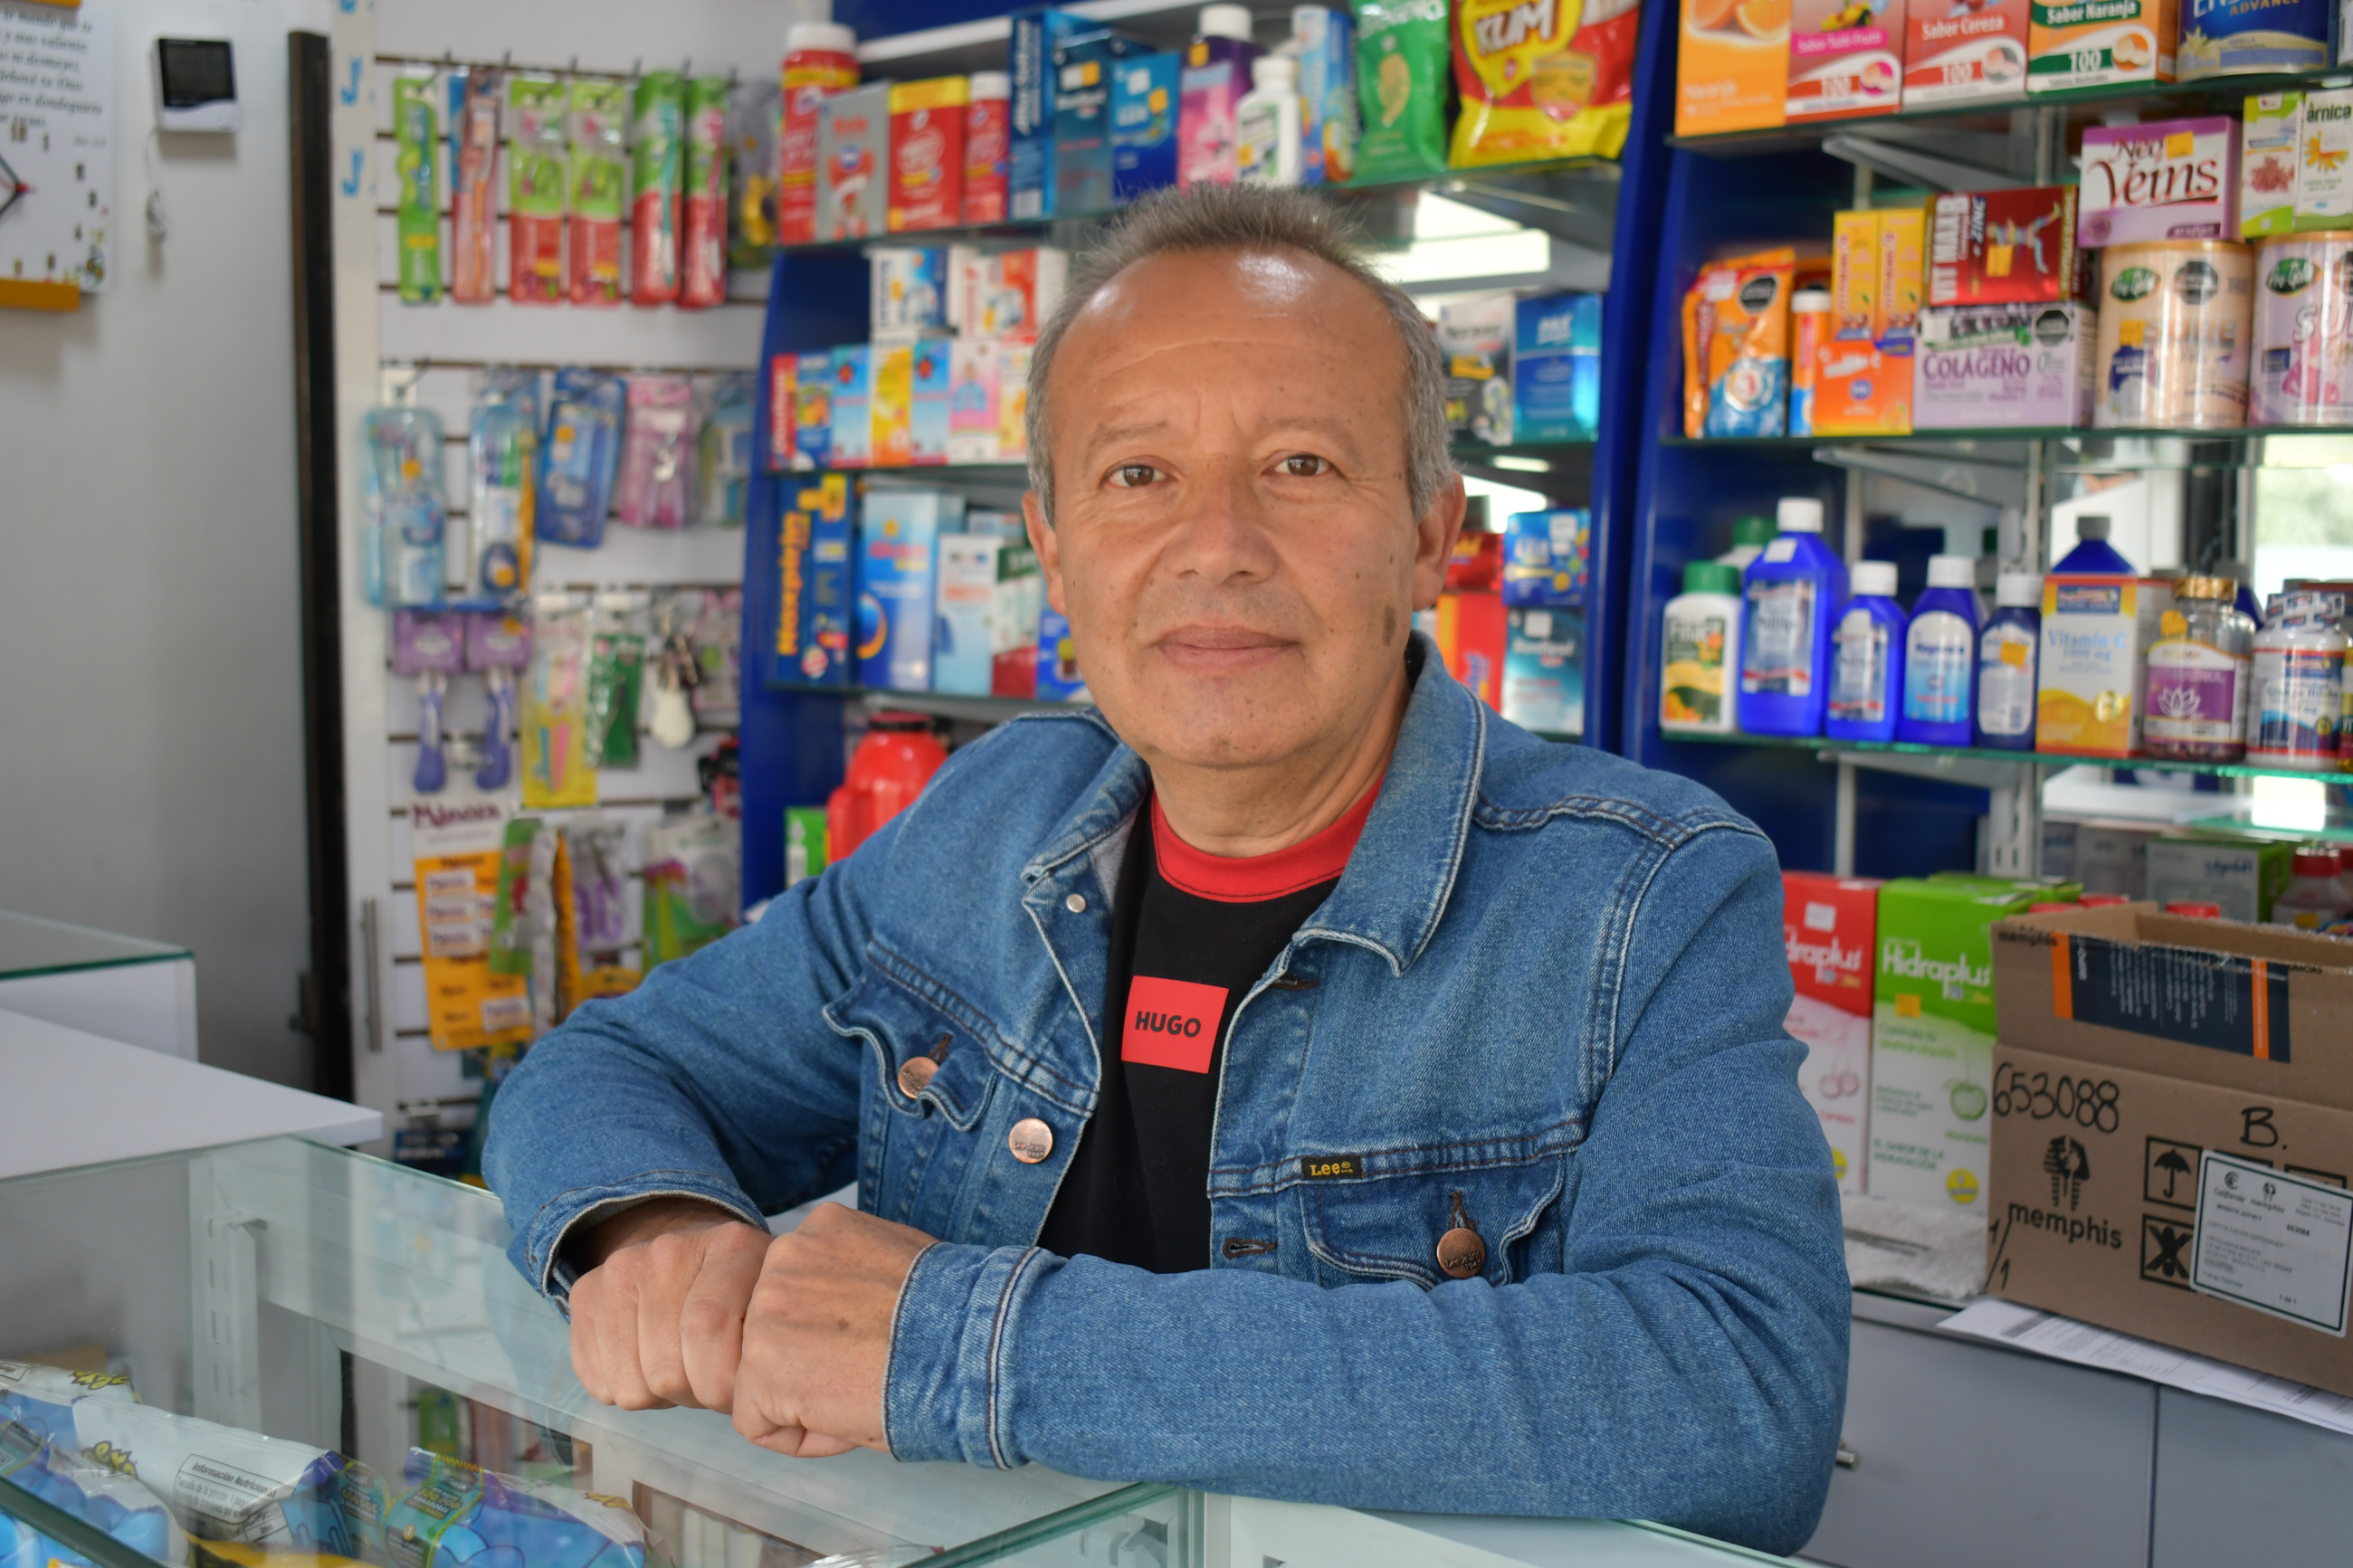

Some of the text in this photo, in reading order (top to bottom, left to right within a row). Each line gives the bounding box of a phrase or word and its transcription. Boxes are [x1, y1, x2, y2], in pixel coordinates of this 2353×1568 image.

[1921, 15, 2005, 41] Sabor Cereza
[2047, 1, 2137, 24] Sabor Naranja
[1941, 64, 1974, 85] 100
[2069, 51, 2102, 72] 100
[2085, 157, 2219, 209] Veins
[1970, 196, 1986, 243] ZINC
[1933, 216, 1958, 263] MAX
[1931, 266, 1958, 302] VIT
[2049, 630, 2110, 648] Vitamin
[1785, 927, 1862, 984] draplus
[1883, 944, 1991, 1000] Hidraplus
[1134, 1010, 1202, 1040] HUGO
[1992, 1061, 2120, 1135] 653088
[2009, 1201, 2122, 1250] memphis
[192, 1461, 277, 1498] Información Nutricional
